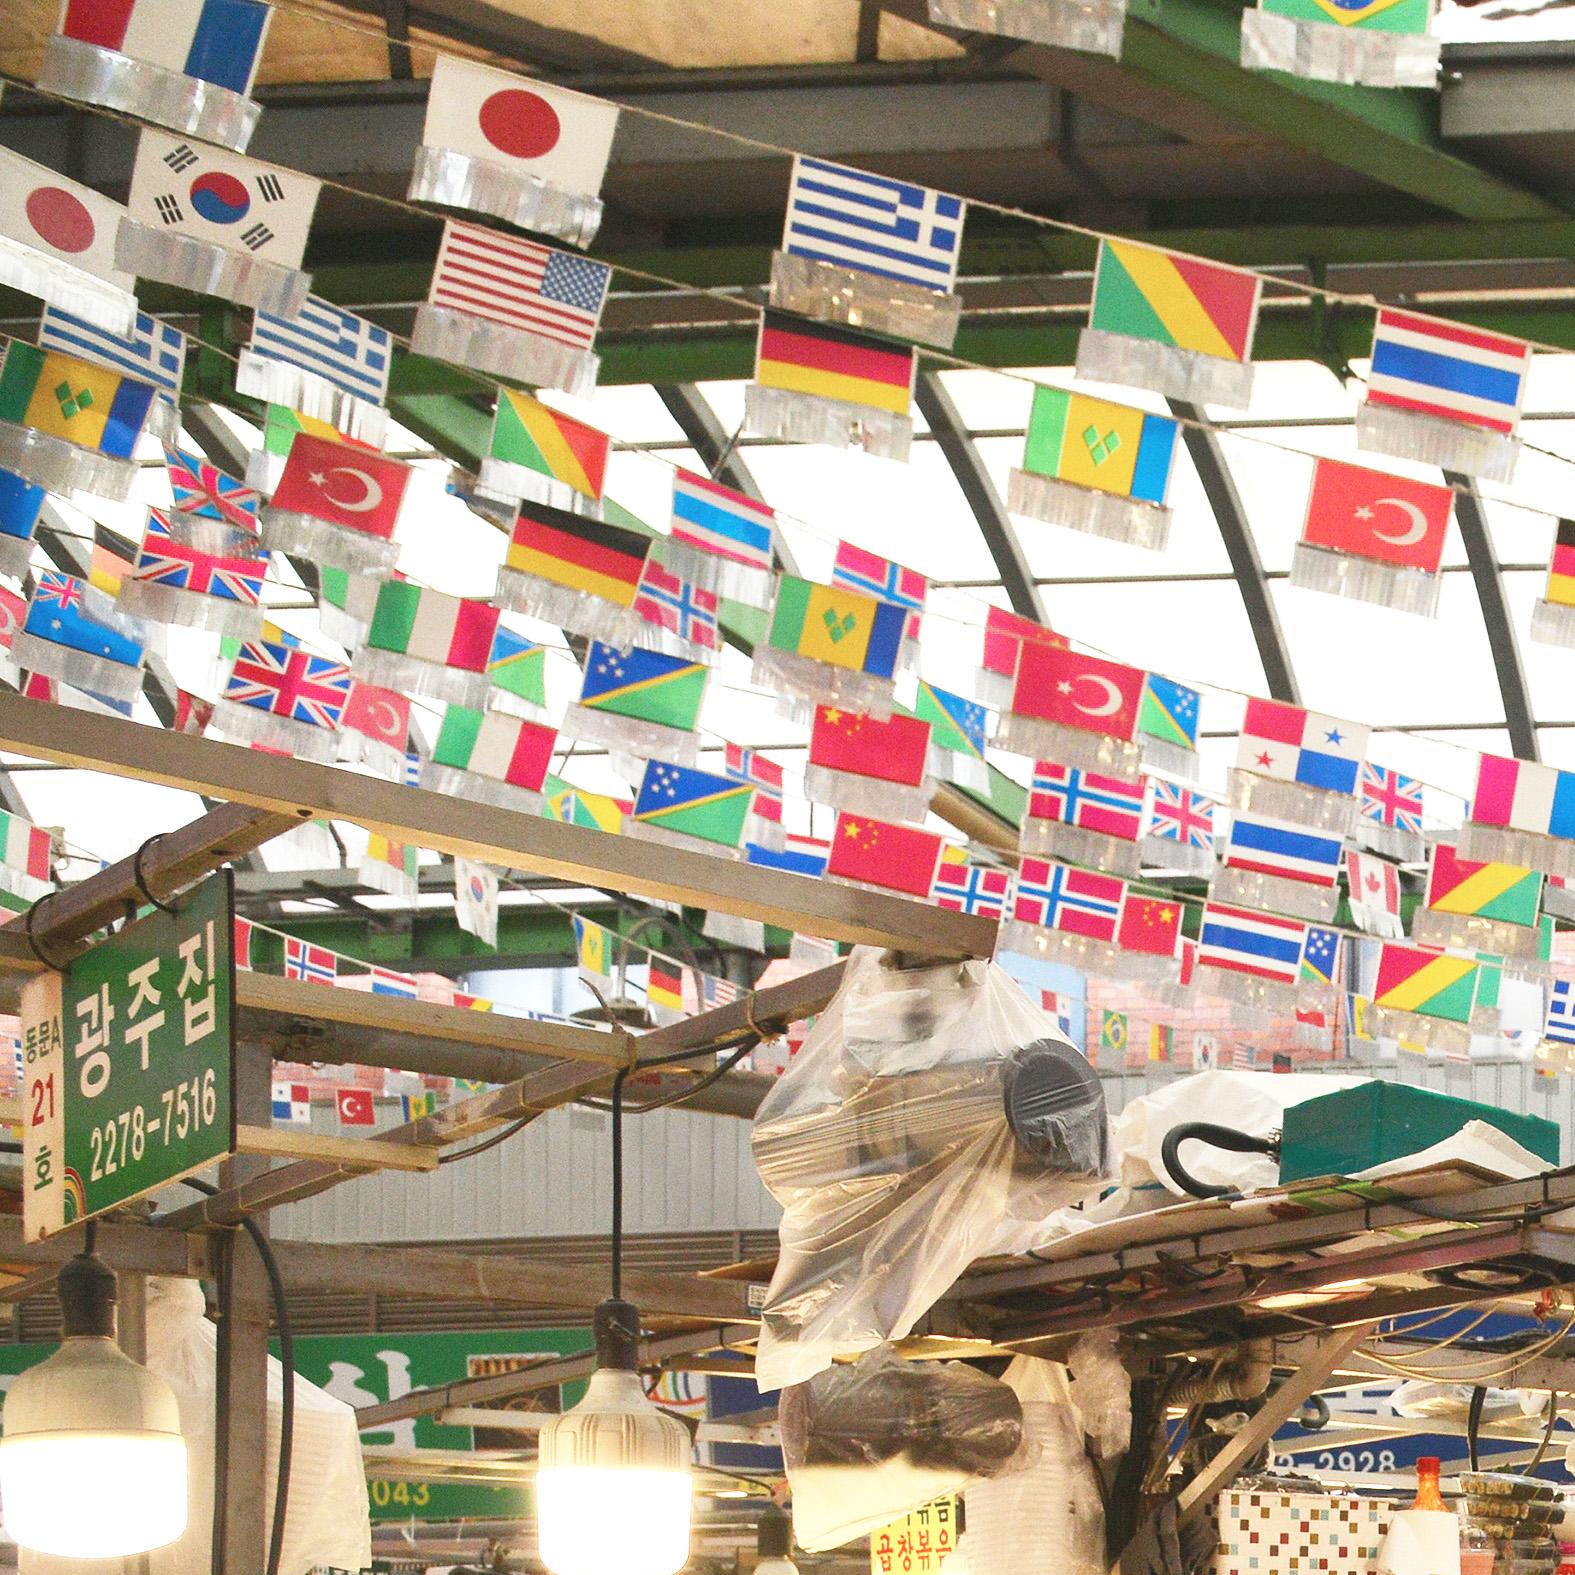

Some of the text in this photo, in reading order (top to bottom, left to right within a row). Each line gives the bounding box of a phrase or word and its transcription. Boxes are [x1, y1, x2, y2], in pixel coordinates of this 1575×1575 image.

[75, 920, 216, 1098] 광주집
[25, 1014, 62, 1064] 동문A
[31, 1073, 55, 1127] 21
[90, 1067, 216, 1183] 2278-7516
[34, 1145, 53, 1192] 호
[876, 1529, 952, 1572] 곱창볶음
